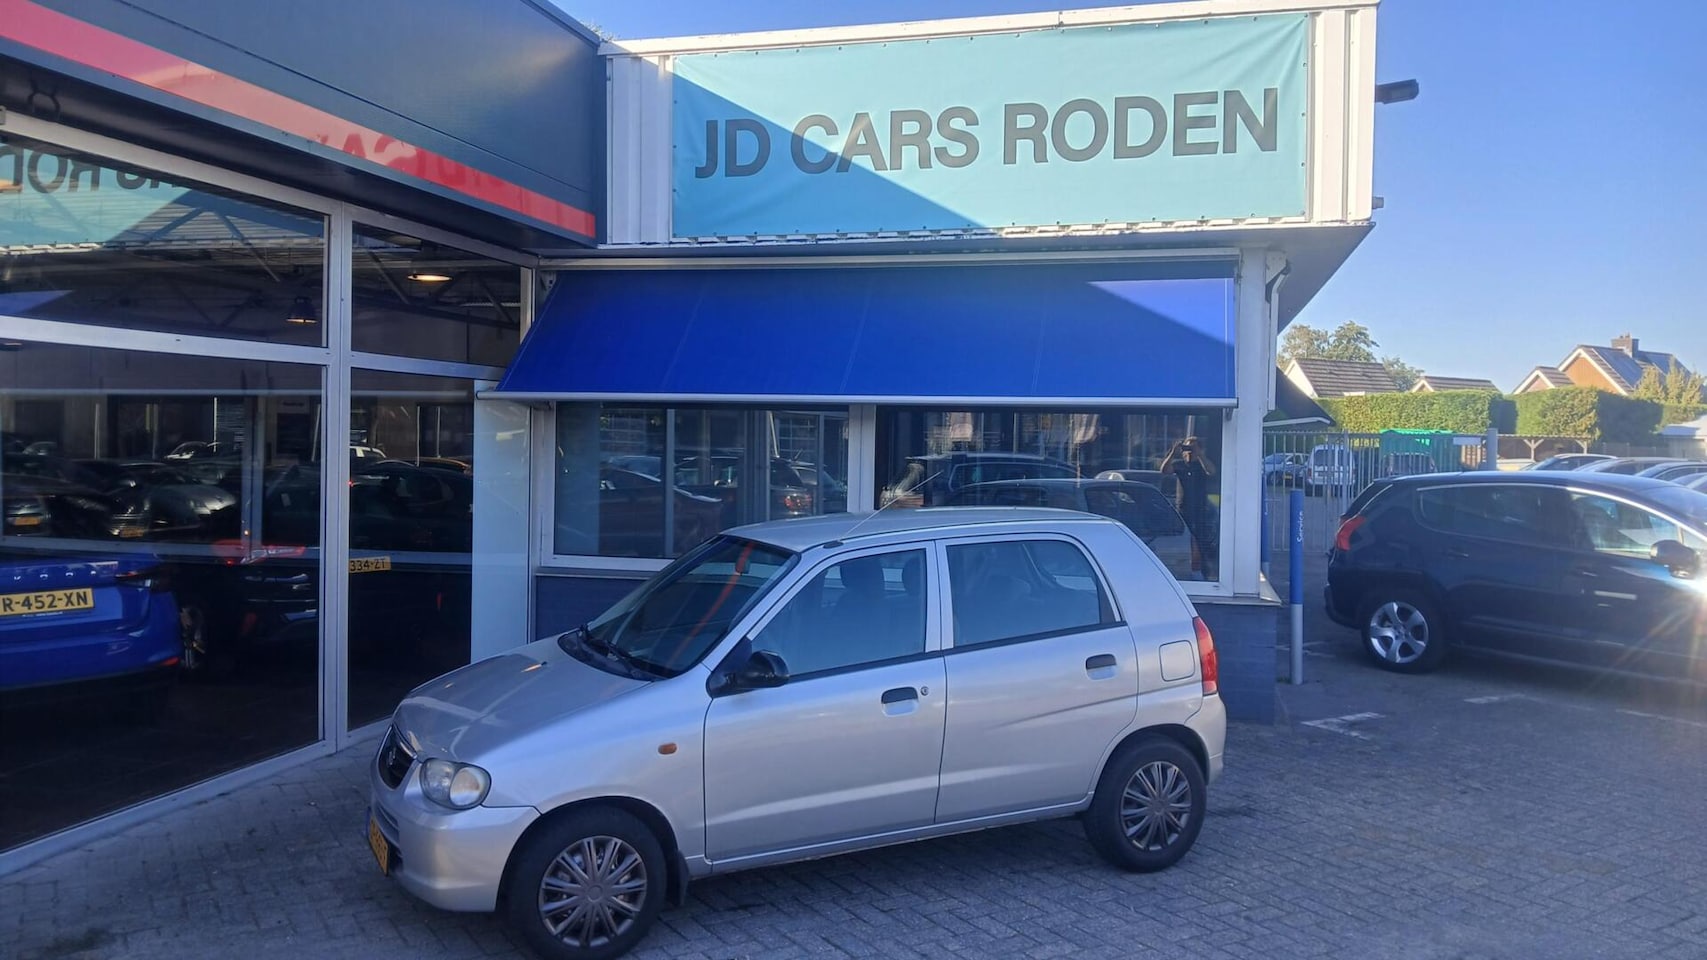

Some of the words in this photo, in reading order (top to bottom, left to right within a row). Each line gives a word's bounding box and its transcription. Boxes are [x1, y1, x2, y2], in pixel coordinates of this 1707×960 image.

[694, 117, 771, 179] JD
[790, 105, 980, 175] CARS
[1003, 87, 1279, 165] RODEN
[2, 591, 89, 612] R-452-XN
